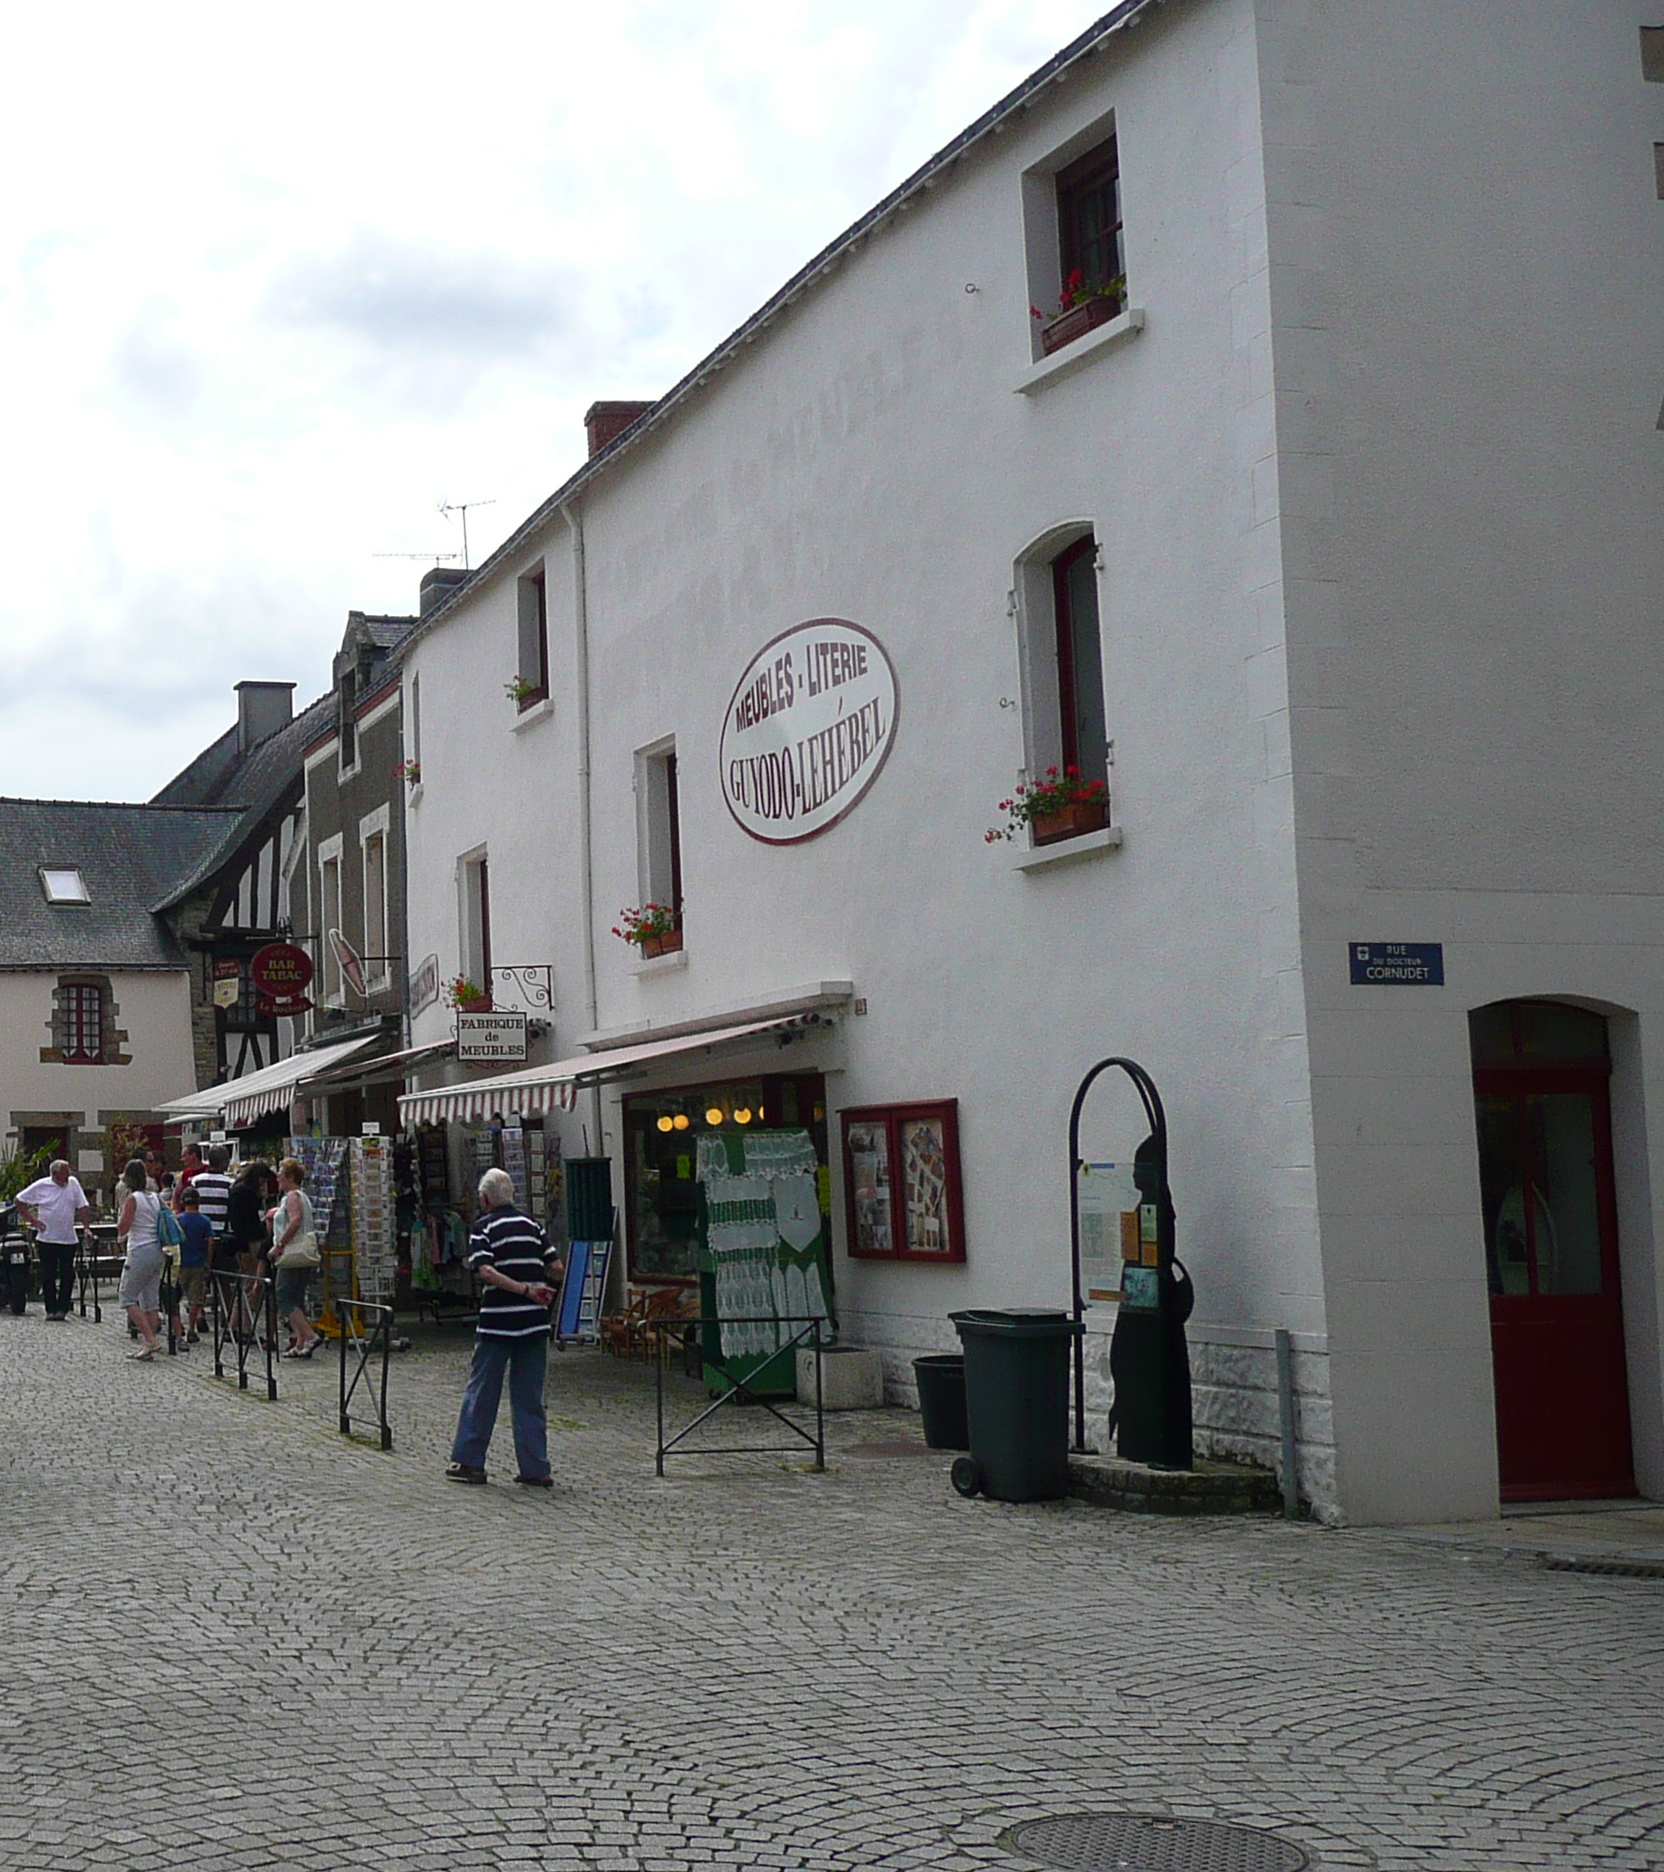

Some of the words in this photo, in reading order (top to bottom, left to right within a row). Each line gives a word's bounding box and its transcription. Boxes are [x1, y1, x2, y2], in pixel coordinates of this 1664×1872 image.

[736, 651, 795, 734] MEUBLES
[806, 642, 868, 698] LITERIE
[1386, 945, 1408, 955] RUE
[268, 960, 296, 970] BAR
[1373, 958, 1384, 966] DU
[1387, 958, 1422, 966] DOCTEUR
[261, 970, 303, 980] TABAC
[1366, 967, 1430, 979] CORNUDET
[460, 1019, 524, 1030] FABRIQUE
[484, 1031, 500, 1042] de
[460, 1045, 525, 1056] MEUBLES
